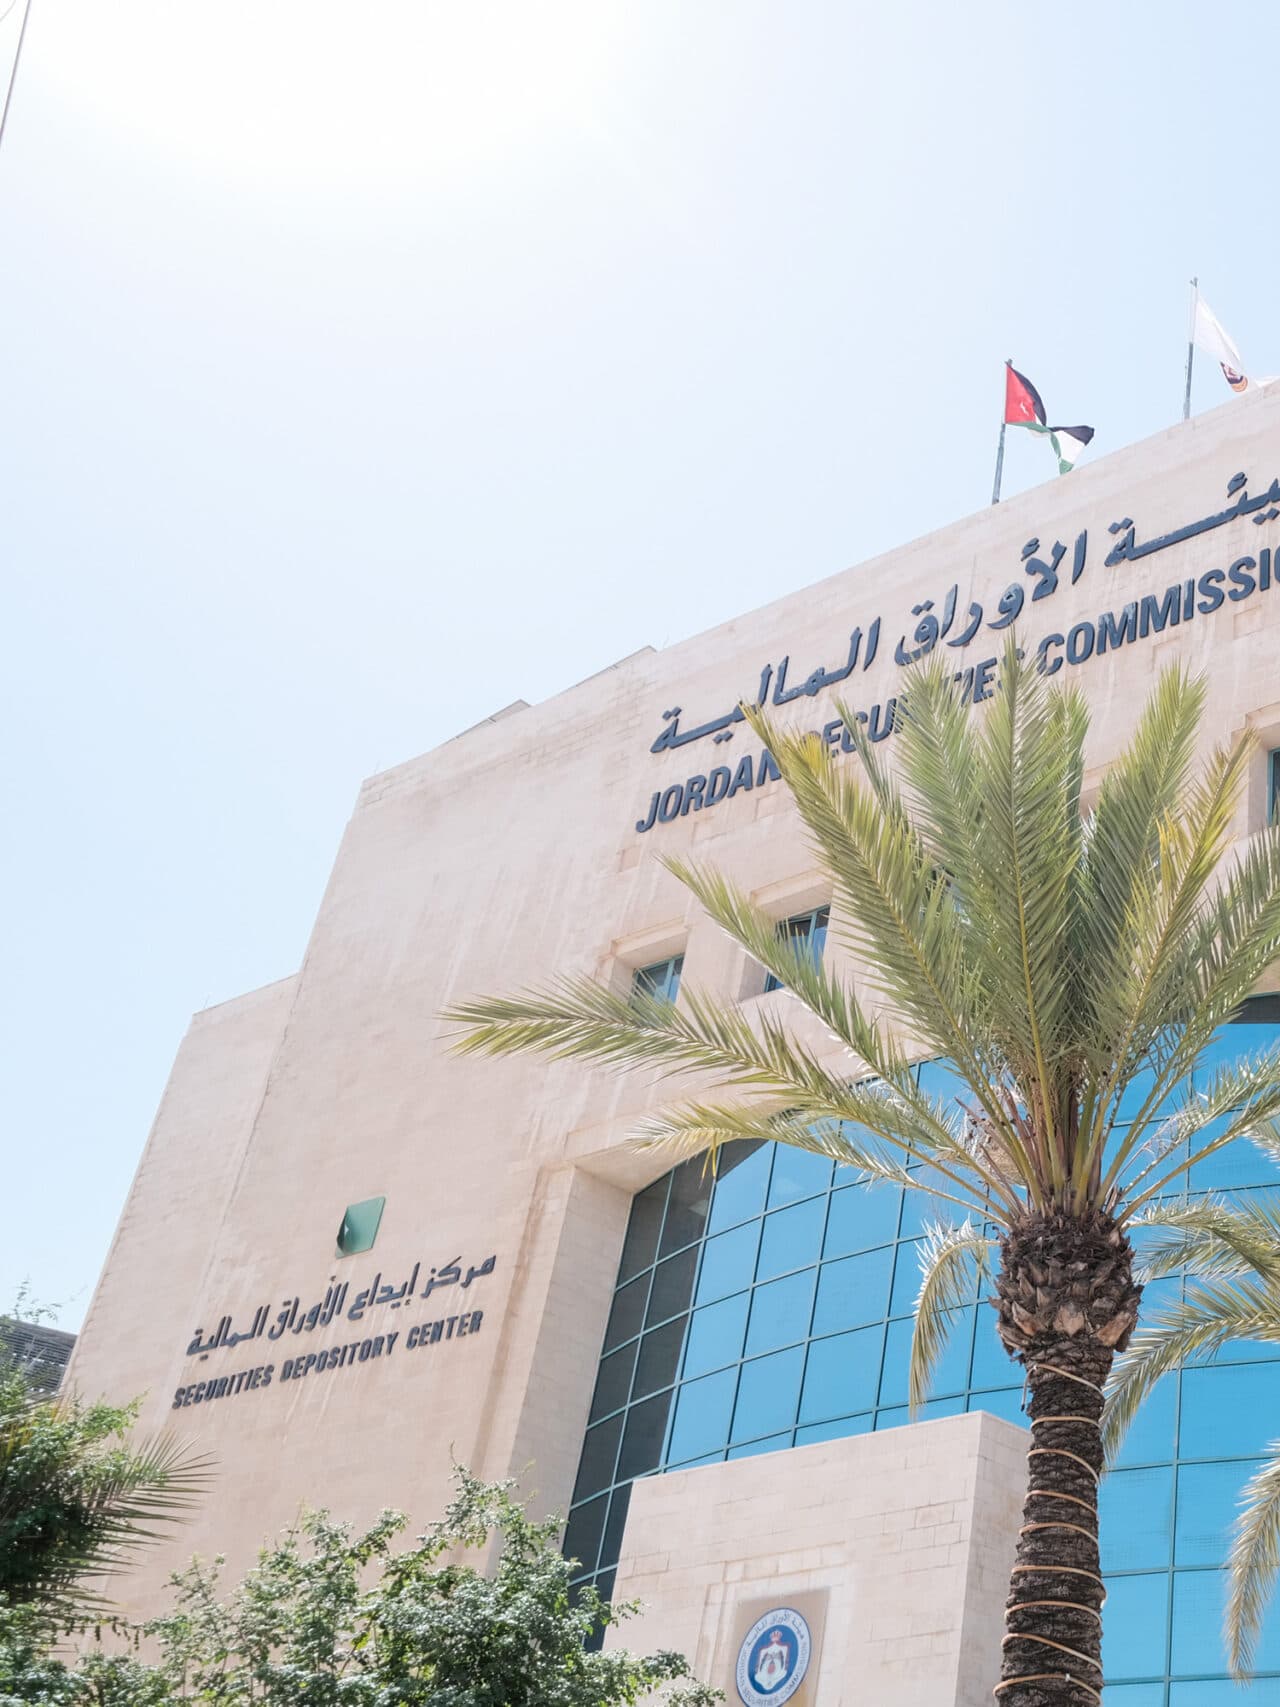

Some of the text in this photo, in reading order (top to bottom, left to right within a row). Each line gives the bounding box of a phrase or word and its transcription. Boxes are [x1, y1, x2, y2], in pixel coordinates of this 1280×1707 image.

[893, 528, 1088, 667] الأوراق
[649, 616, 881, 754] المالية
[172, 1310, 484, 1410] SECURITIES DEPOSITORY CENTER
[186, 1254, 497, 1362] مركز إيداع الأوراق المالية
